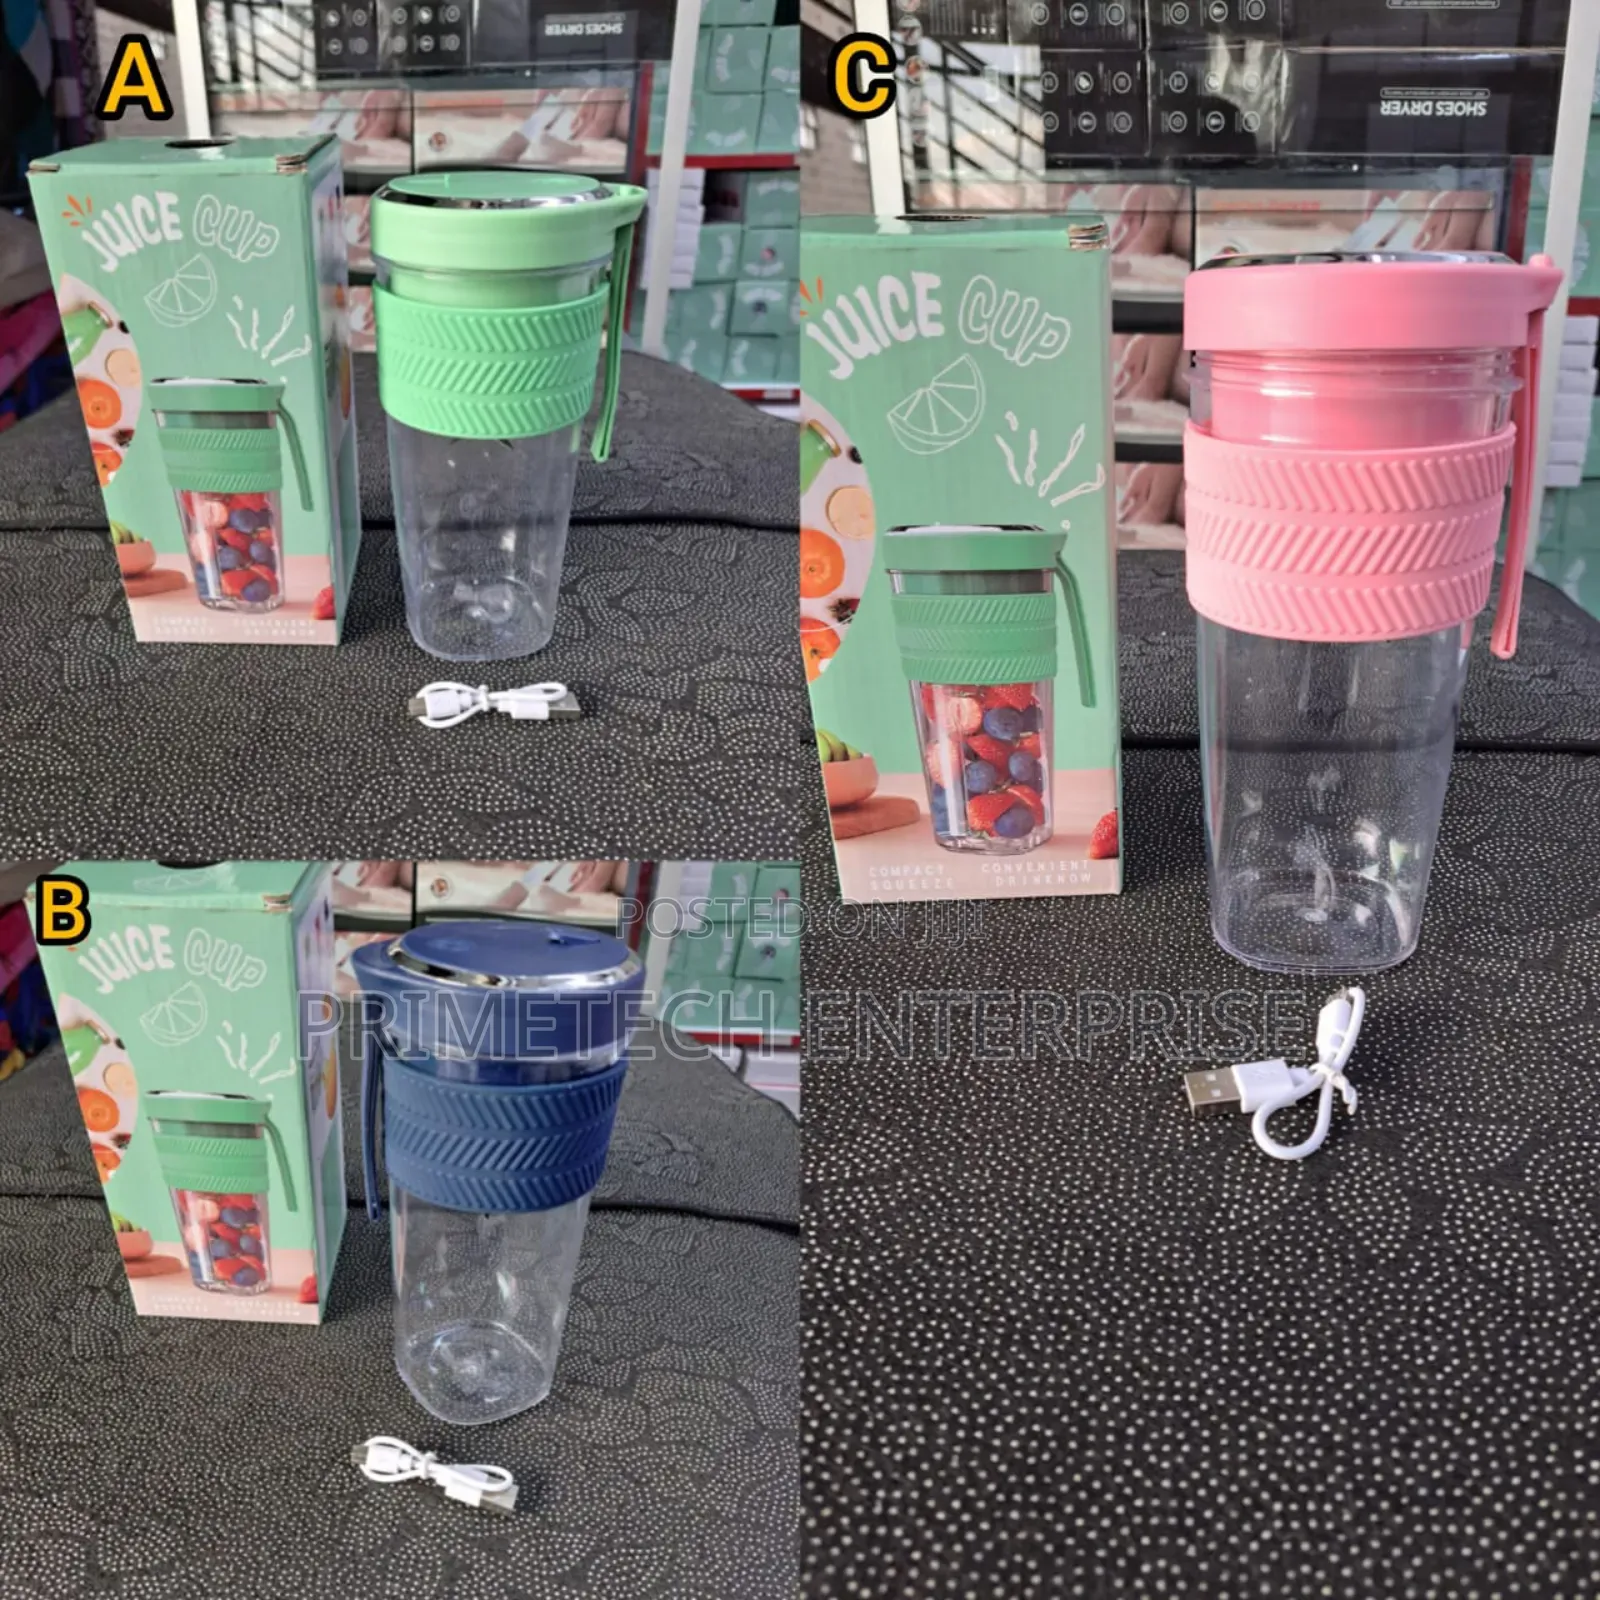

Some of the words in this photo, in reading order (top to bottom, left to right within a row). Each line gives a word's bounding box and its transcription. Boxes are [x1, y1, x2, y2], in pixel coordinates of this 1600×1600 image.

[1380, 100, 1433, 116] DRYER
[1435, 101, 1488, 117] SHOES
[81, 191, 183, 273] JUICE
[193, 193, 280, 262] CUP
[806, 270, 945, 380] JUICE
[958, 274, 1071, 367] CUP
[869, 864, 944, 878] COMPACT
[981, 859, 1088, 873] CONVENIENT
[77, 923, 175, 994] JUICE
[184, 927, 267, 992] CUP
